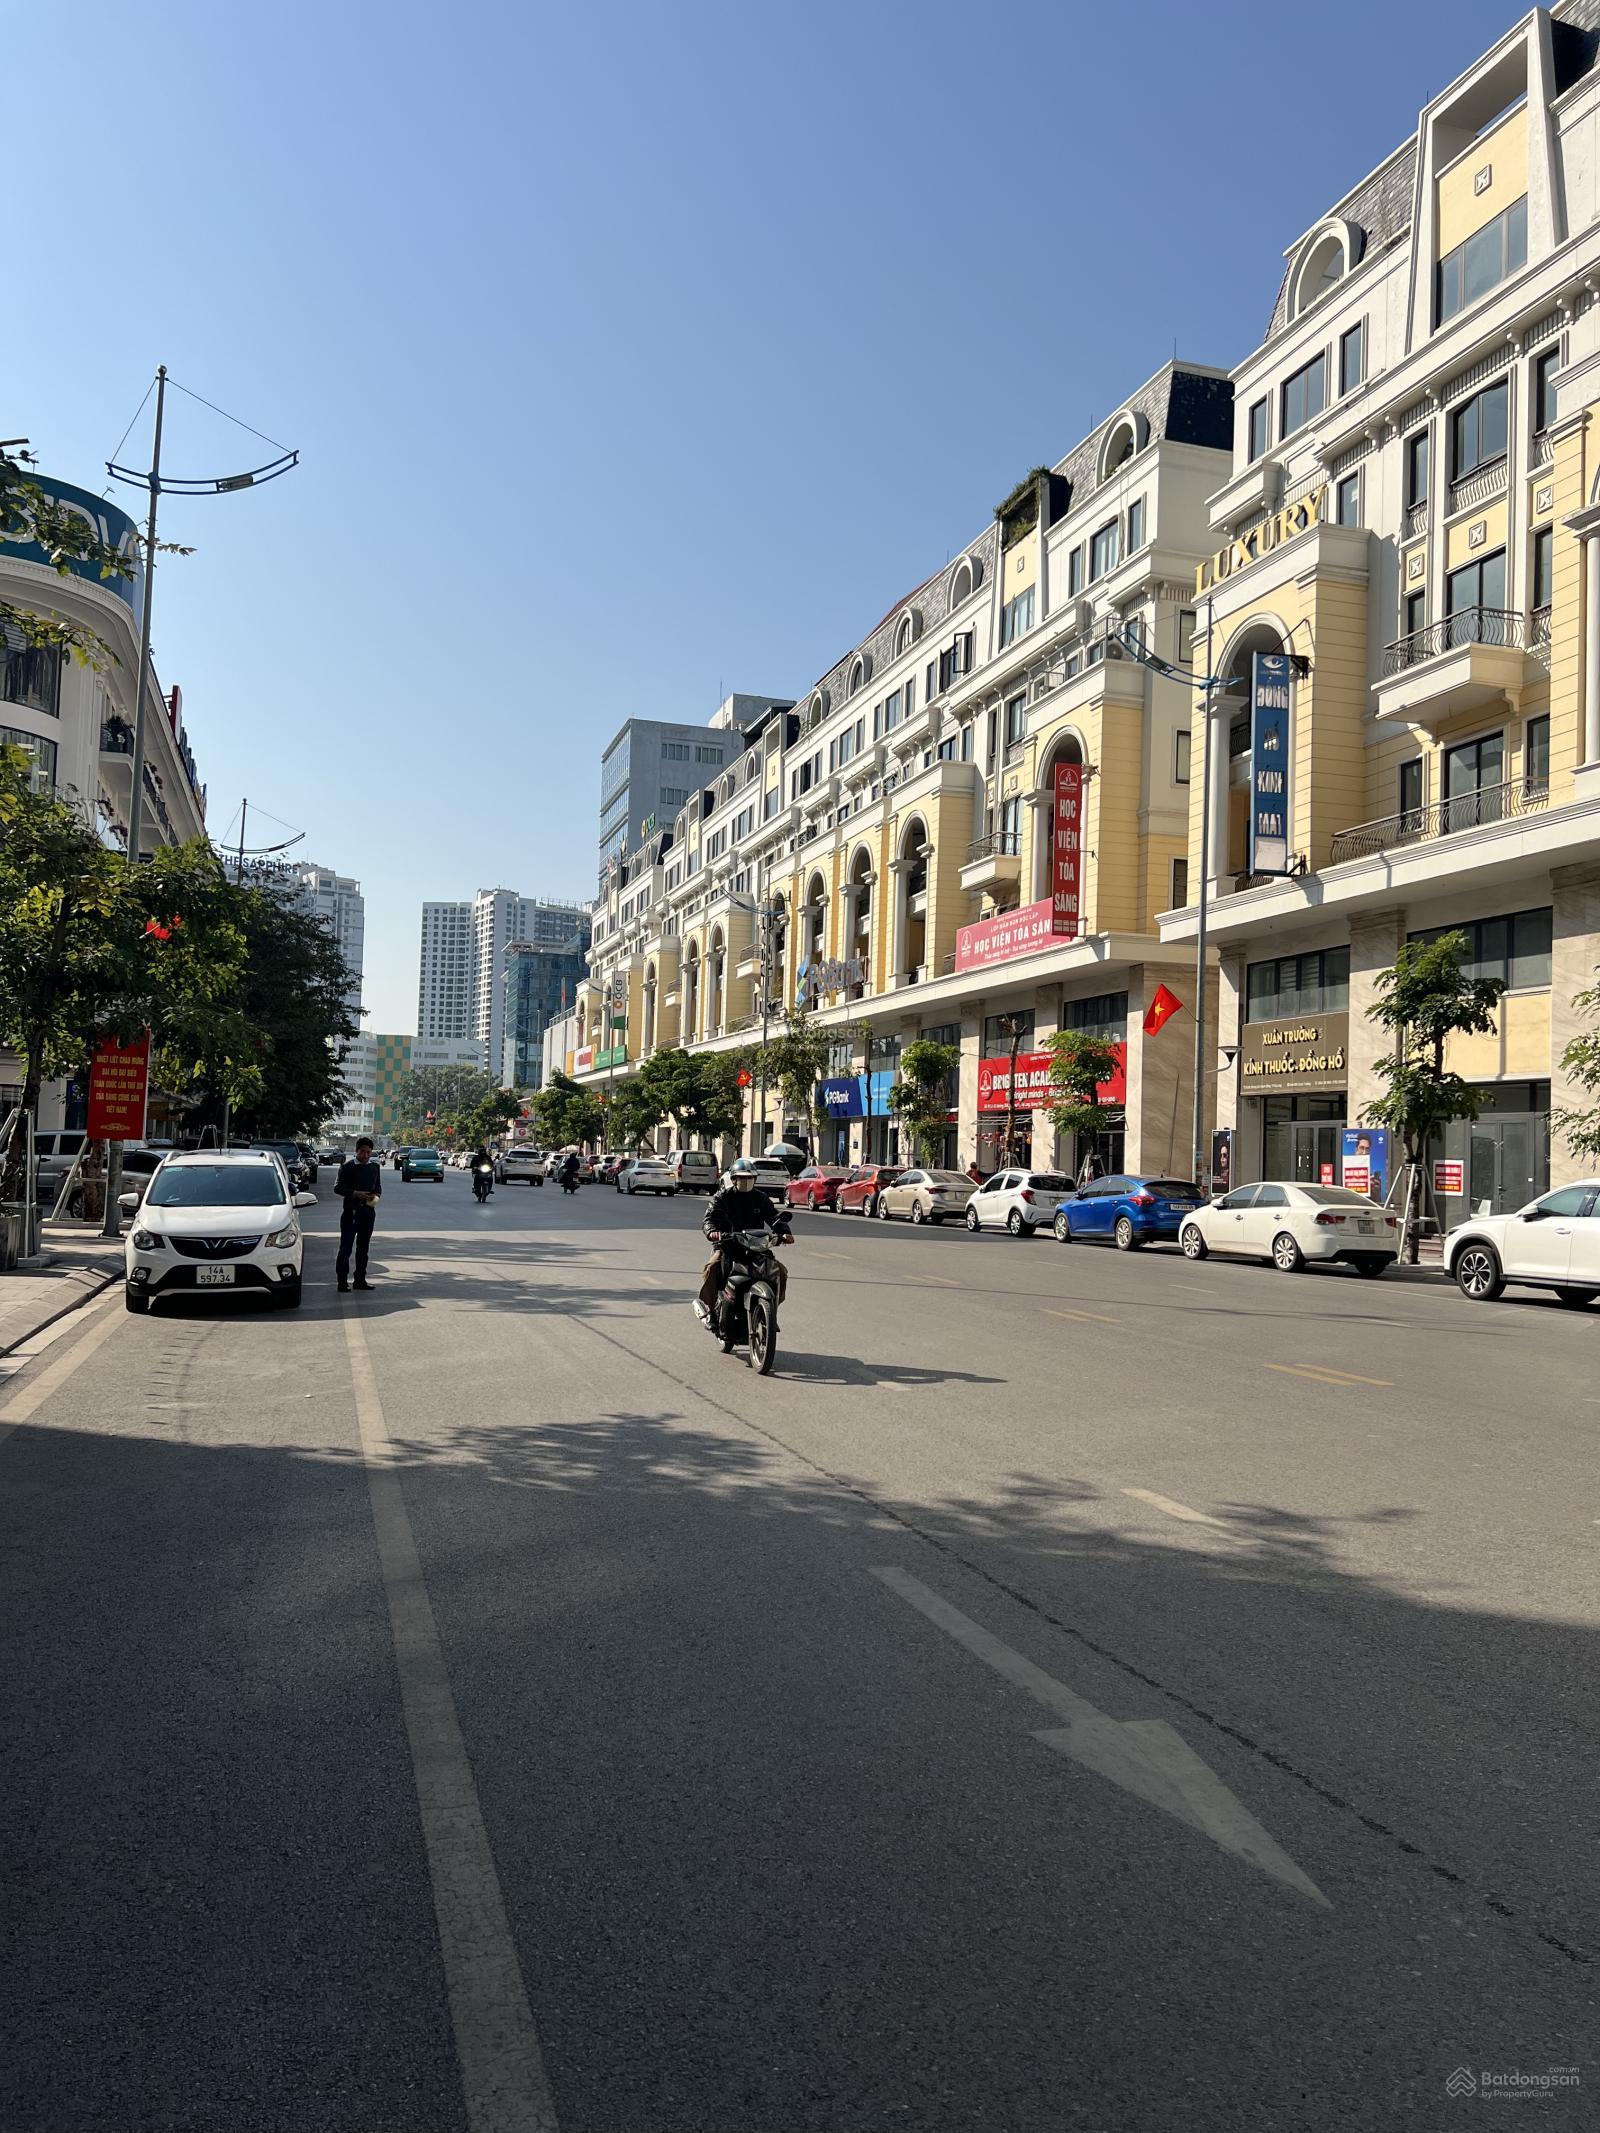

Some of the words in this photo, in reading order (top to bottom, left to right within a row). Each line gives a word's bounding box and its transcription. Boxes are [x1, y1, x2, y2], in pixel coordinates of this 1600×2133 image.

[1195, 484, 1327, 597] LUXURY
[1059, 800, 1076, 821] HỌC
[1058, 828, 1077, 852] VIỆN
[243, 857, 299, 874] SAPPHIRE
[1059, 856, 1075, 881] TỎA
[1054, 890, 1077, 913] SÁNG
[974, 938, 990, 955] HỌC
[992, 930, 1011, 949] VIỆN
[1263, 1028, 1283, 1046] XUÂN
[1284, 1025, 1317, 1042] TRƯỜNG
[1244, 1058, 1263, 1075] KÍNH
[1264, 1052, 1295, 1074] THUỐC
[1299, 1050, 1327, 1071] ĐỒNG
[1328, 1046, 1343, 1069] HỒ
[992, 1072, 1029, 1090] BRIGTEN
[828, 1090, 850, 1104] PGBank
[200, 1274, 231, 1283] 597.34
[208, 1266, 224, 1275] 14A
